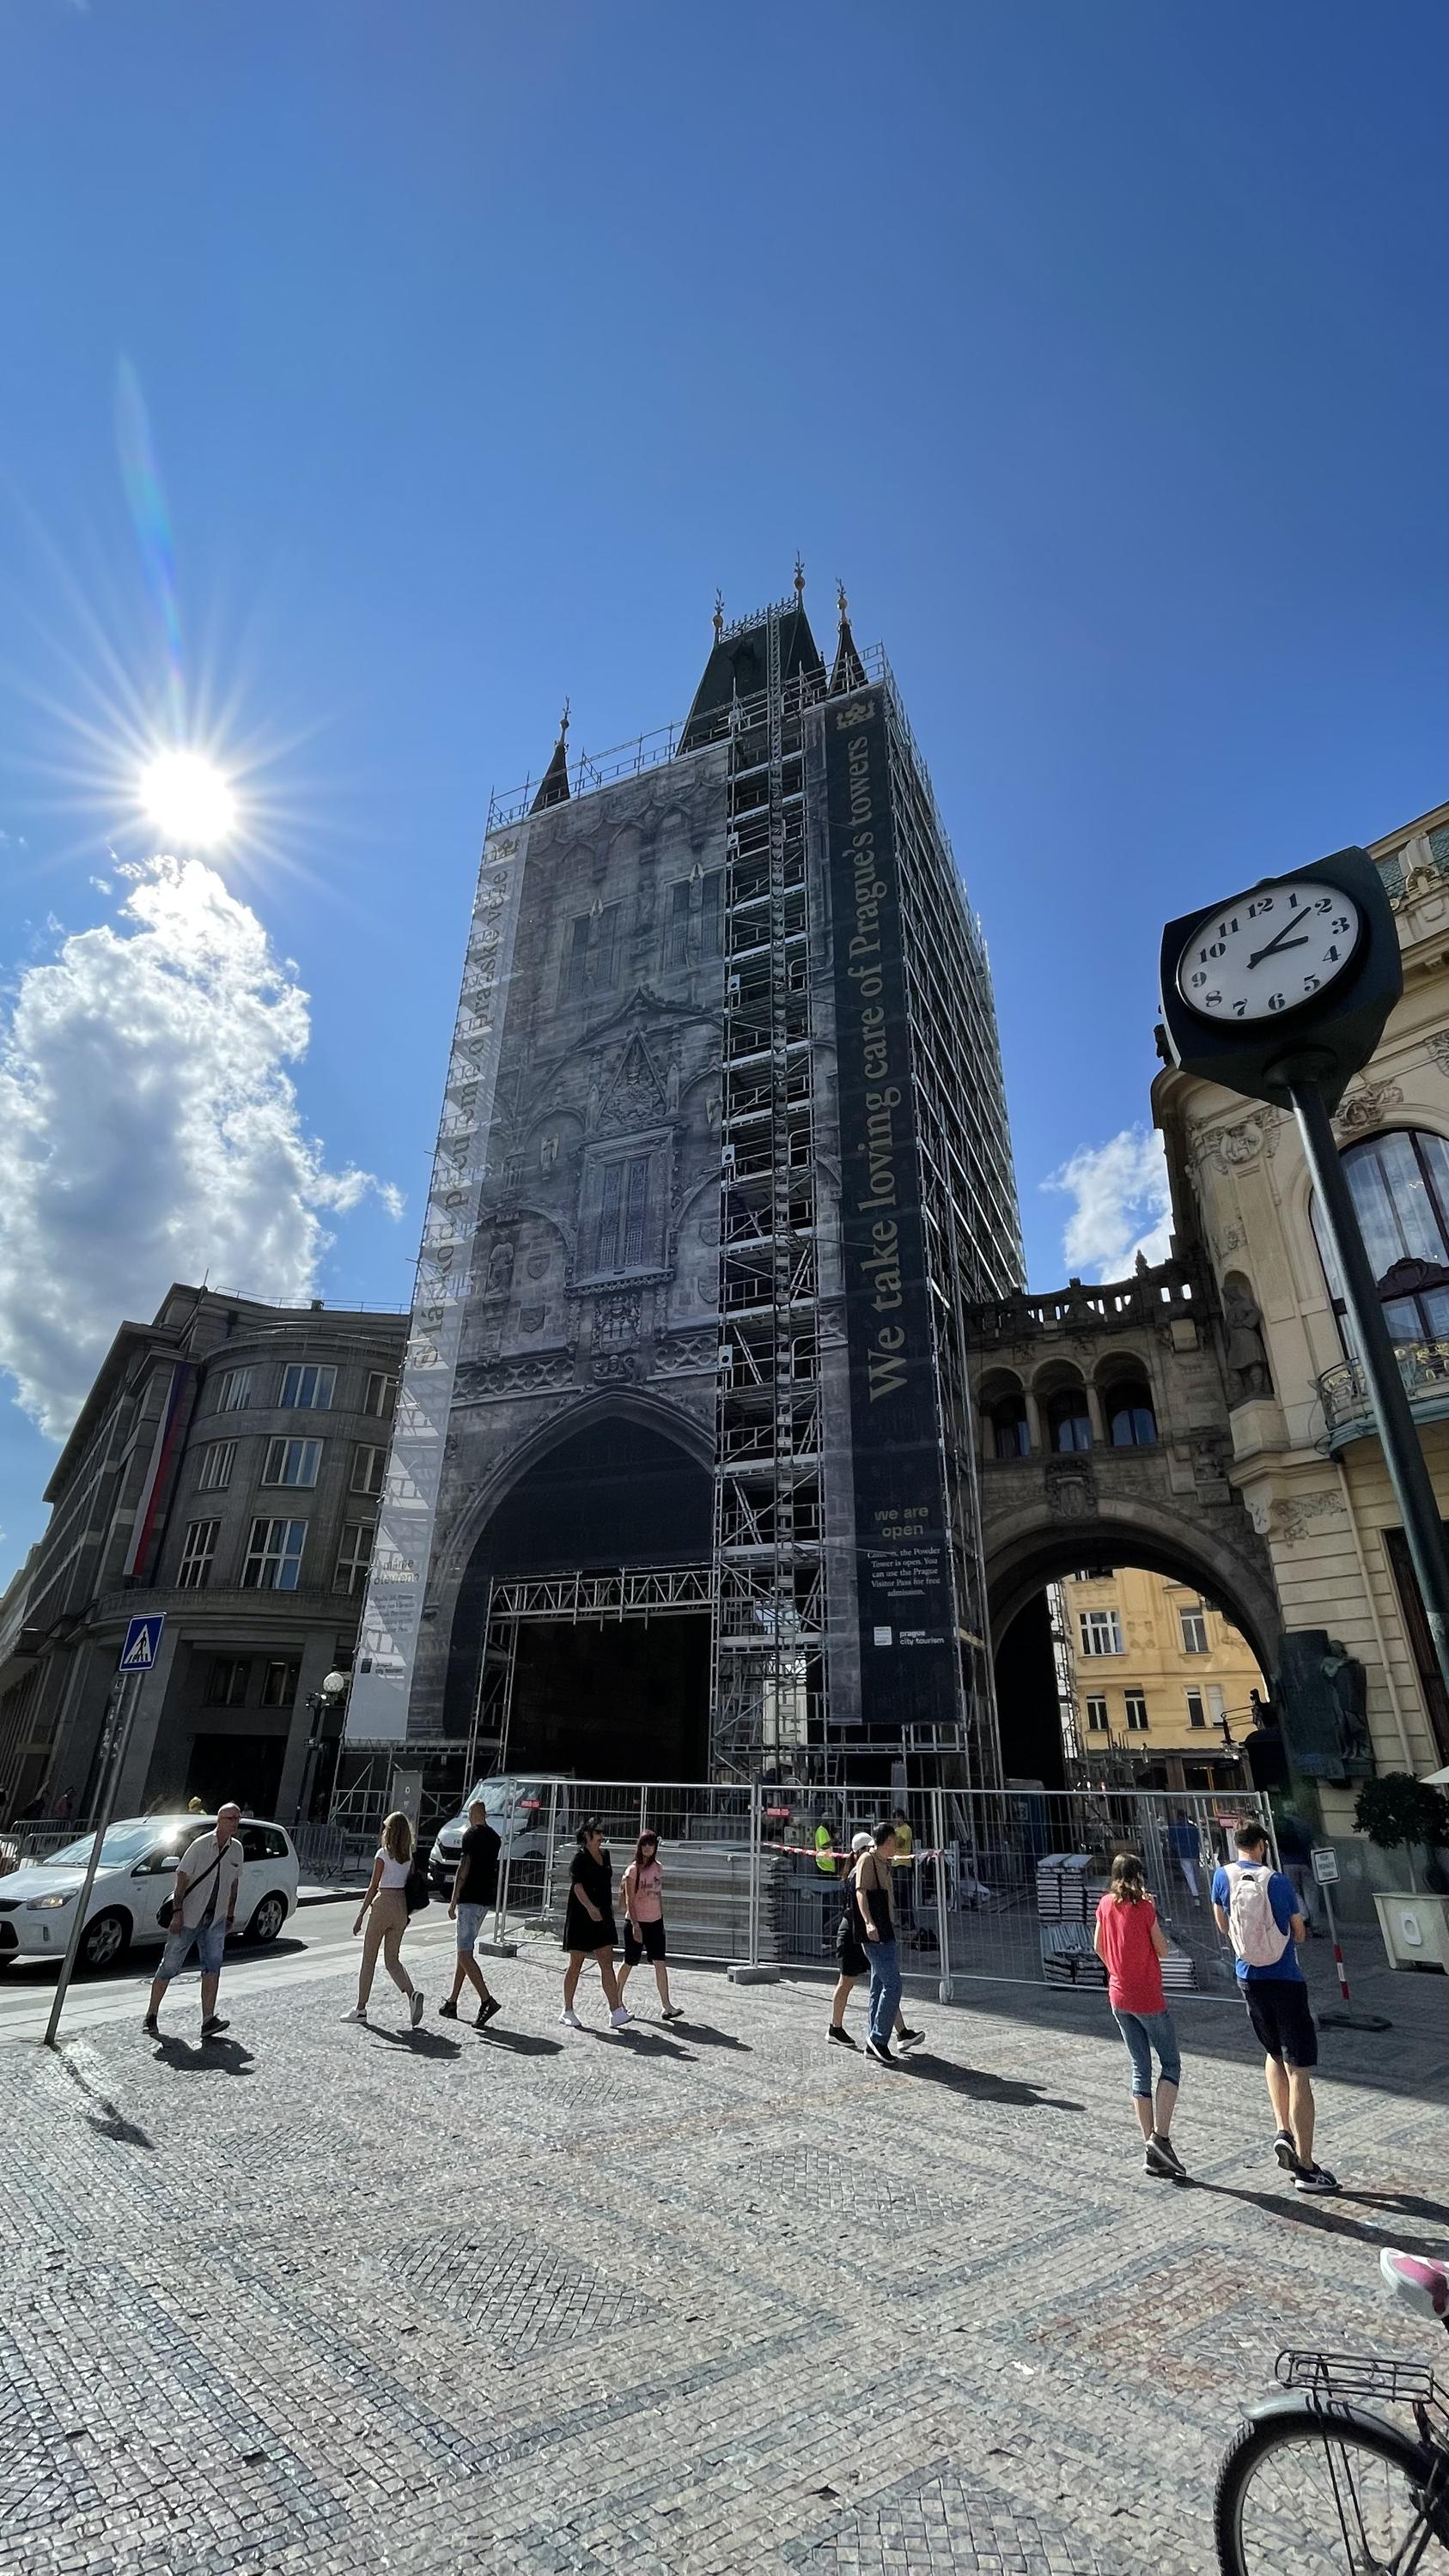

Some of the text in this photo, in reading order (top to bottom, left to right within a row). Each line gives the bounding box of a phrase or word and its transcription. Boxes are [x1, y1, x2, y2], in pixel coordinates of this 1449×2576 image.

[848, 735, 873, 827] towers
[1246, 898, 1274, 920] 12
[1288, 893, 1300, 908] 1
[1315, 898, 1332, 916] 2
[1216, 917, 1243, 939] 11
[1331, 916, 1350, 935] 3
[1196, 942, 1227, 964] 10
[1322, 945, 1342, 963] 4
[848, 963, 886, 999] of
[1191, 971, 1207, 987] 9
[1304, 974, 1320, 992] 5
[1205, 990, 1223, 1008] 8
[1233, 998, 1248, 1017] 7
[1268, 993, 1285, 1010] 6
[468, 1039, 484, 1055] o
[860, 1006, 888, 1079] care
[858, 1085, 901, 1211] loving
[861, 1220, 904, 1313] take
[868, 1326, 908, 1403] We
[874, 1507, 928, 1521] we are
[881, 1524, 923, 1540] open
[914, 1546, 941, 1555] Powder
[900, 1568, 912, 1577] the
[899, 1637, 914, 1646] city
